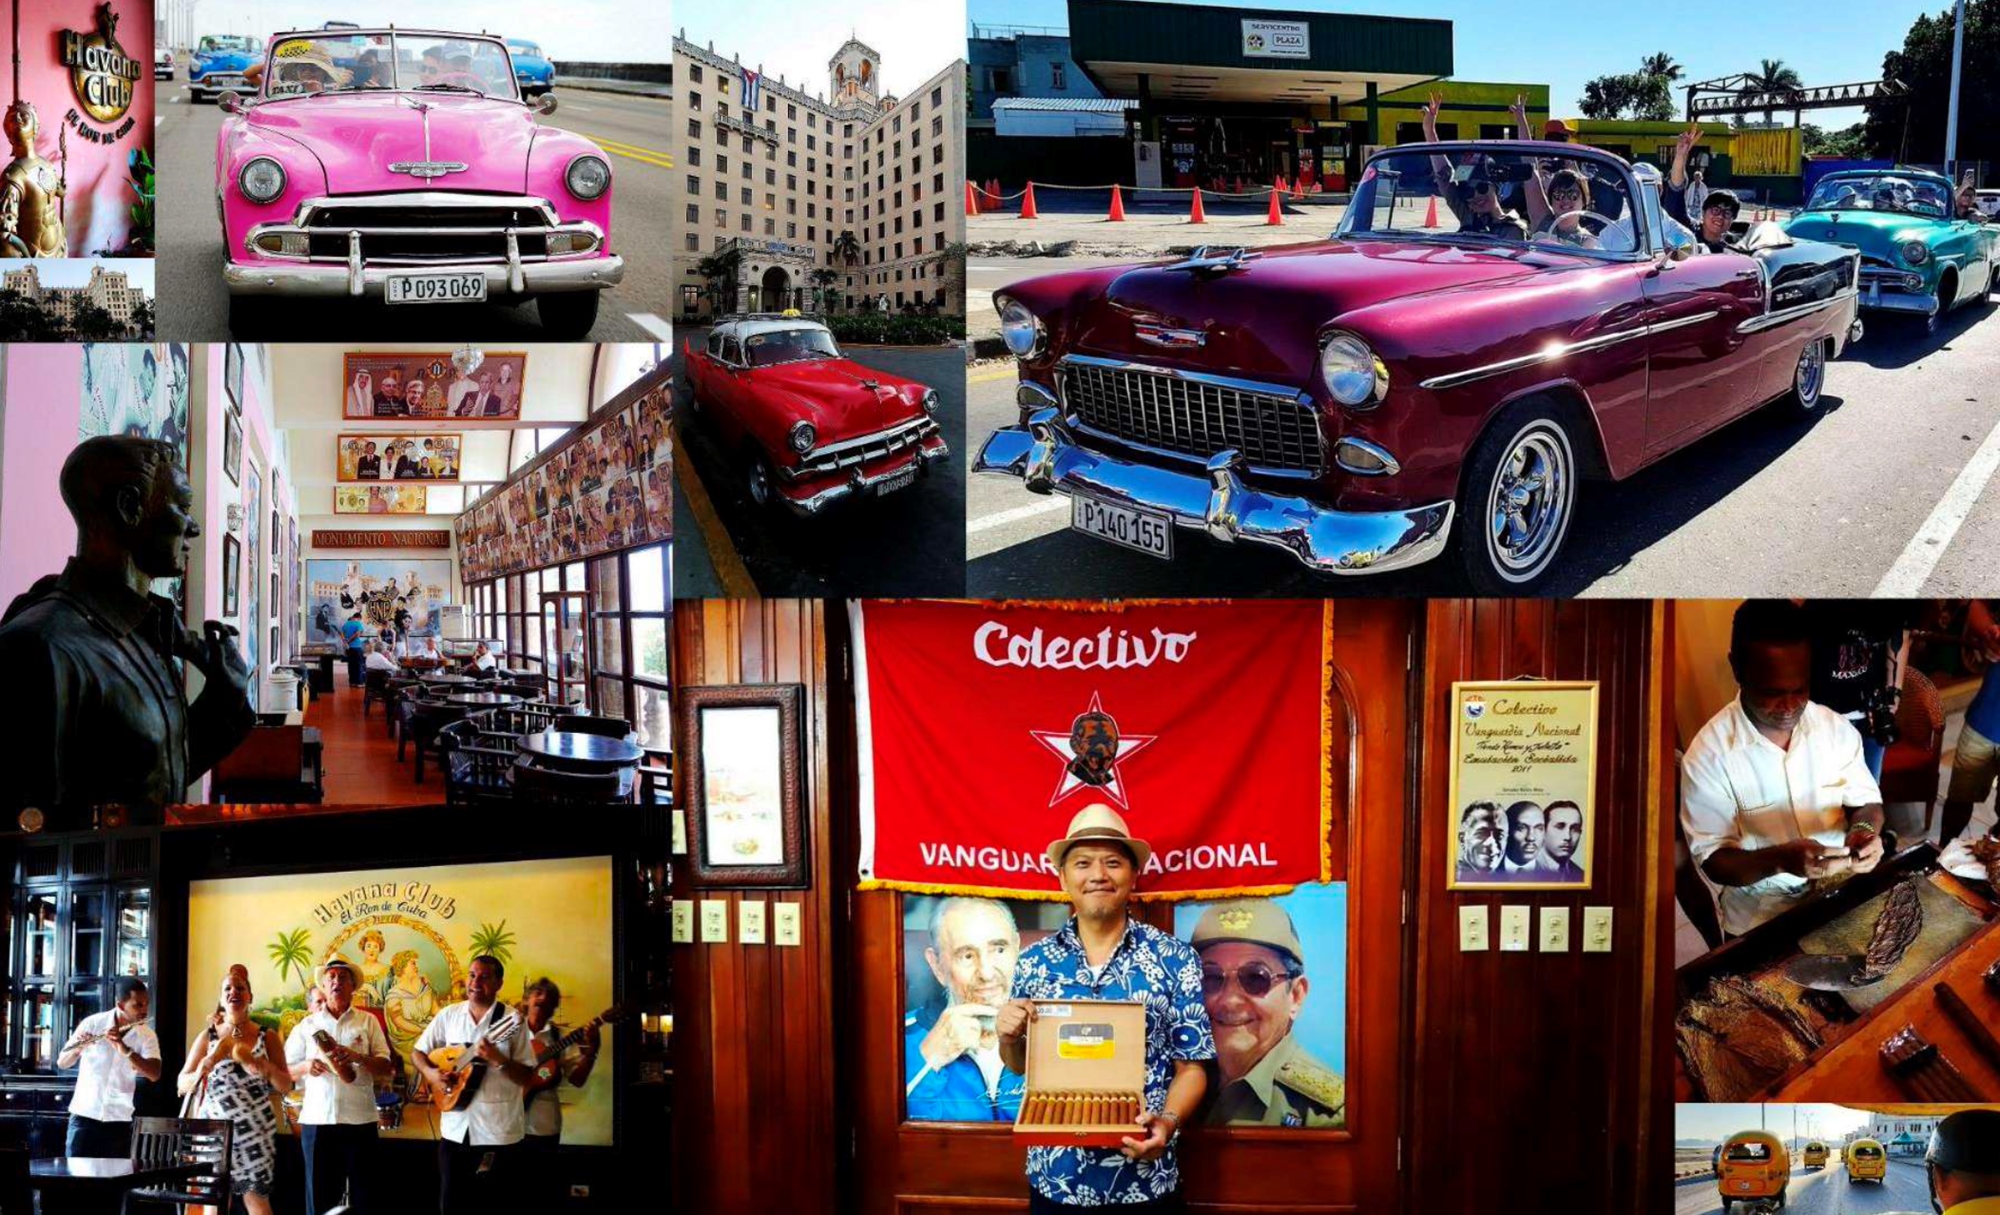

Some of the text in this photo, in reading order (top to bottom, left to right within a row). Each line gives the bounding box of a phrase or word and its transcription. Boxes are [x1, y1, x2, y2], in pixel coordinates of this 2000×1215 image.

[1276, 36, 1300, 44] PLAZA
[64, 30, 141, 79] Havana
[86, 74, 131, 107] Club
[271, 85, 300, 95] TAXI
[316, 531, 447, 546] MONUMENTO NACIONAL
[973, 620, 1197, 670] Colectivo
[1492, 699, 1558, 715] Colectivo
[1465, 722, 1581, 739] Vanguardia Nacional
[919, 842, 1278, 877] VANGUAR ACIONAL
[313, 881, 457, 926] Havana Club
[340, 909, 352, 925] El
[355, 902, 379, 916] Ron
[381, 900, 392, 912] de
[396, 900, 428, 919] Cuba
